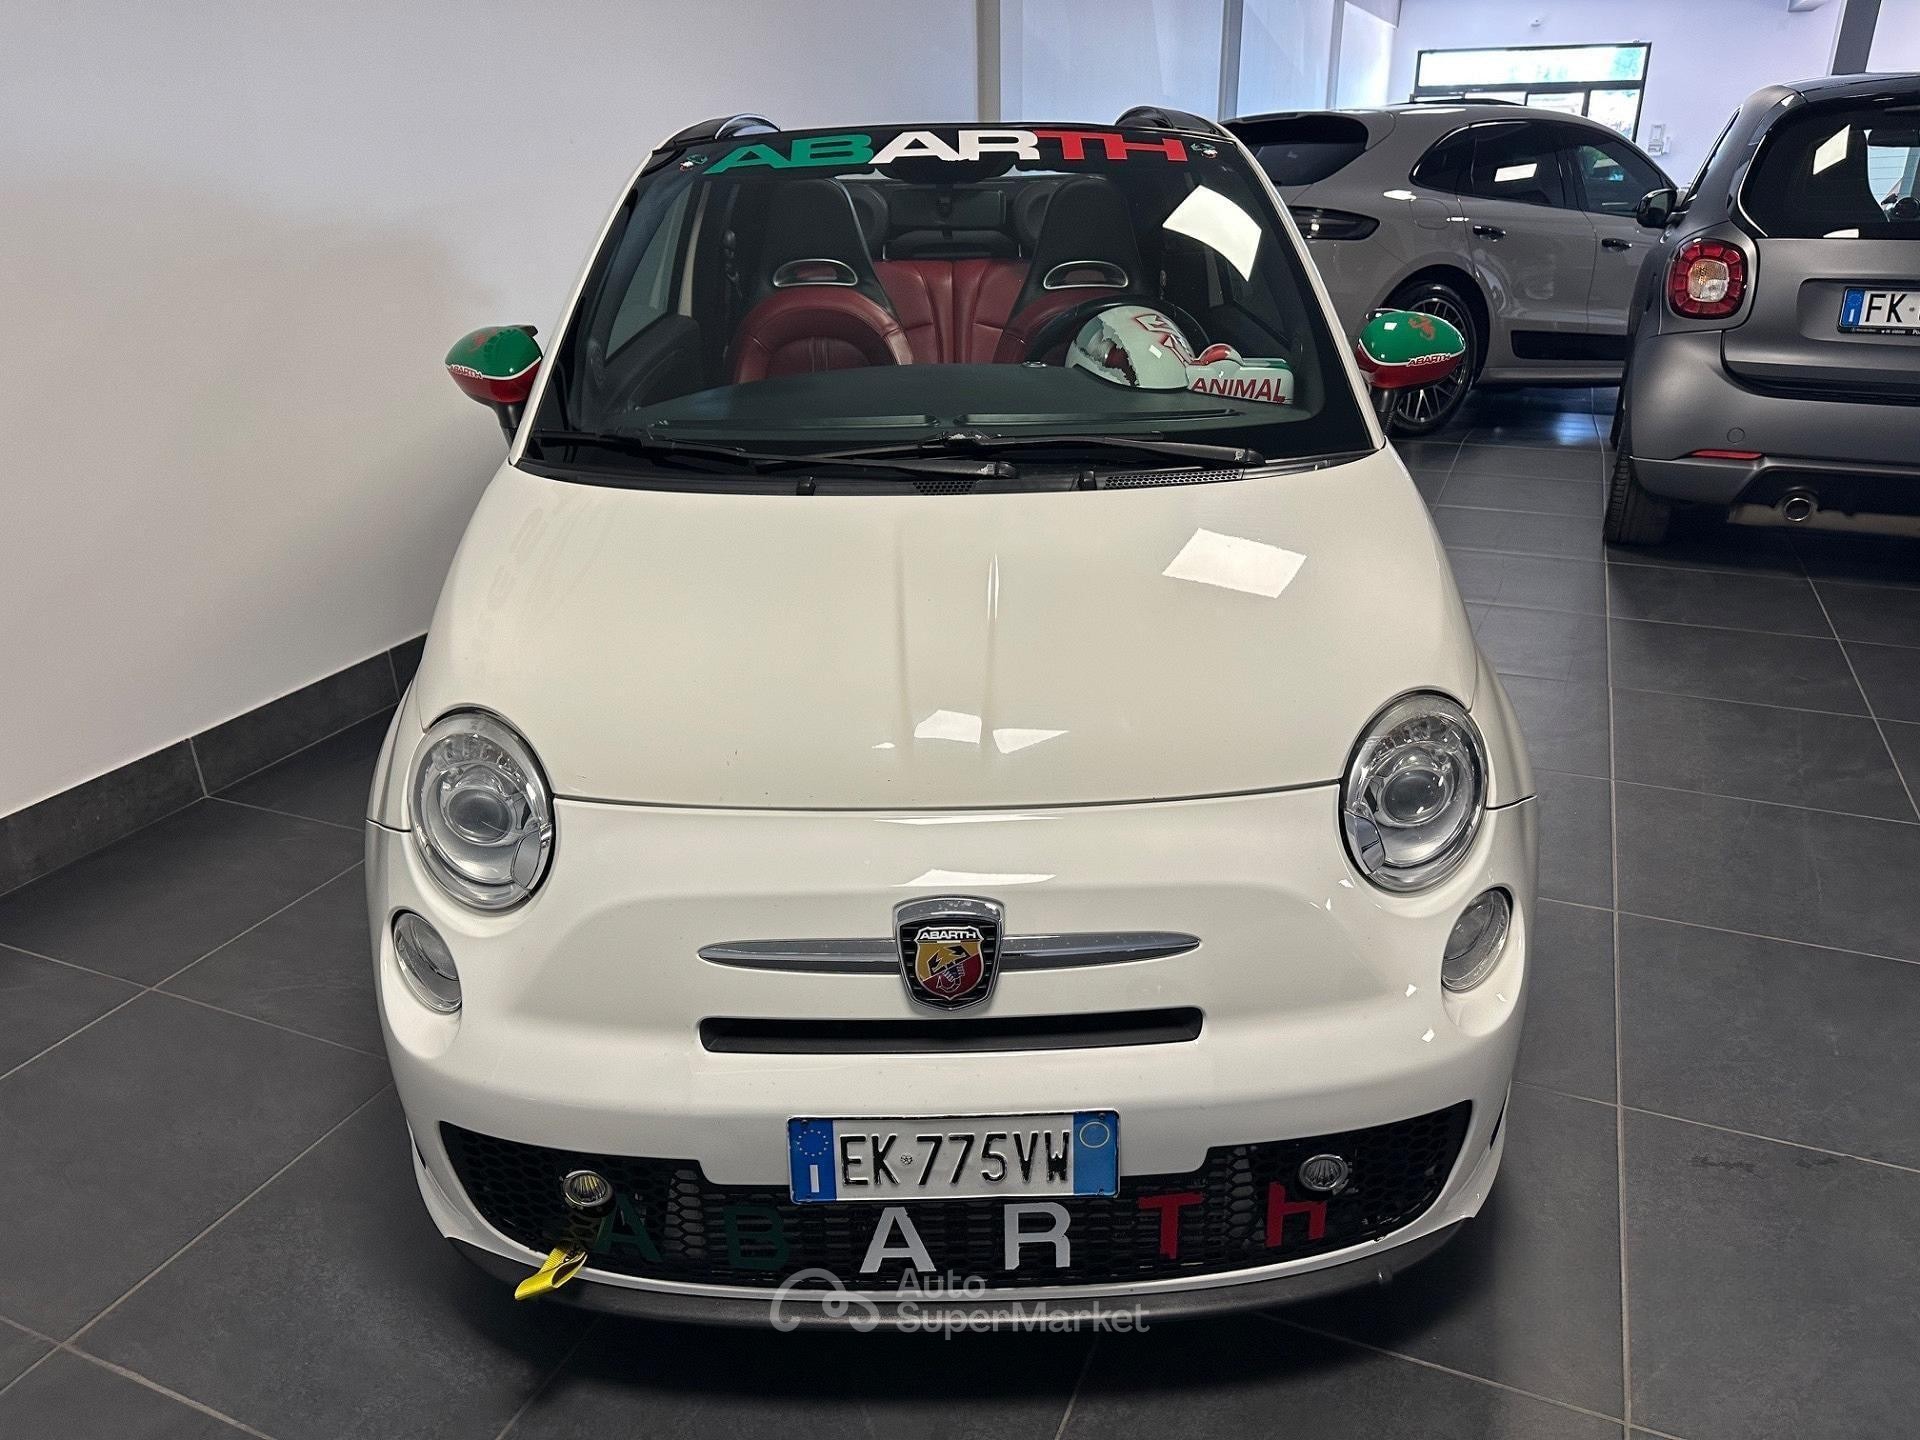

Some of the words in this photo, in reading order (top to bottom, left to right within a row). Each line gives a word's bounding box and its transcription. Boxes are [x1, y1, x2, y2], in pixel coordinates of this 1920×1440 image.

[703, 129, 1189, 174] ABARTH
[1406, 352, 1451, 367] ABARTH
[1190, 376, 1286, 403] ANIMAL
[920, 930, 976, 940] ABARTH
